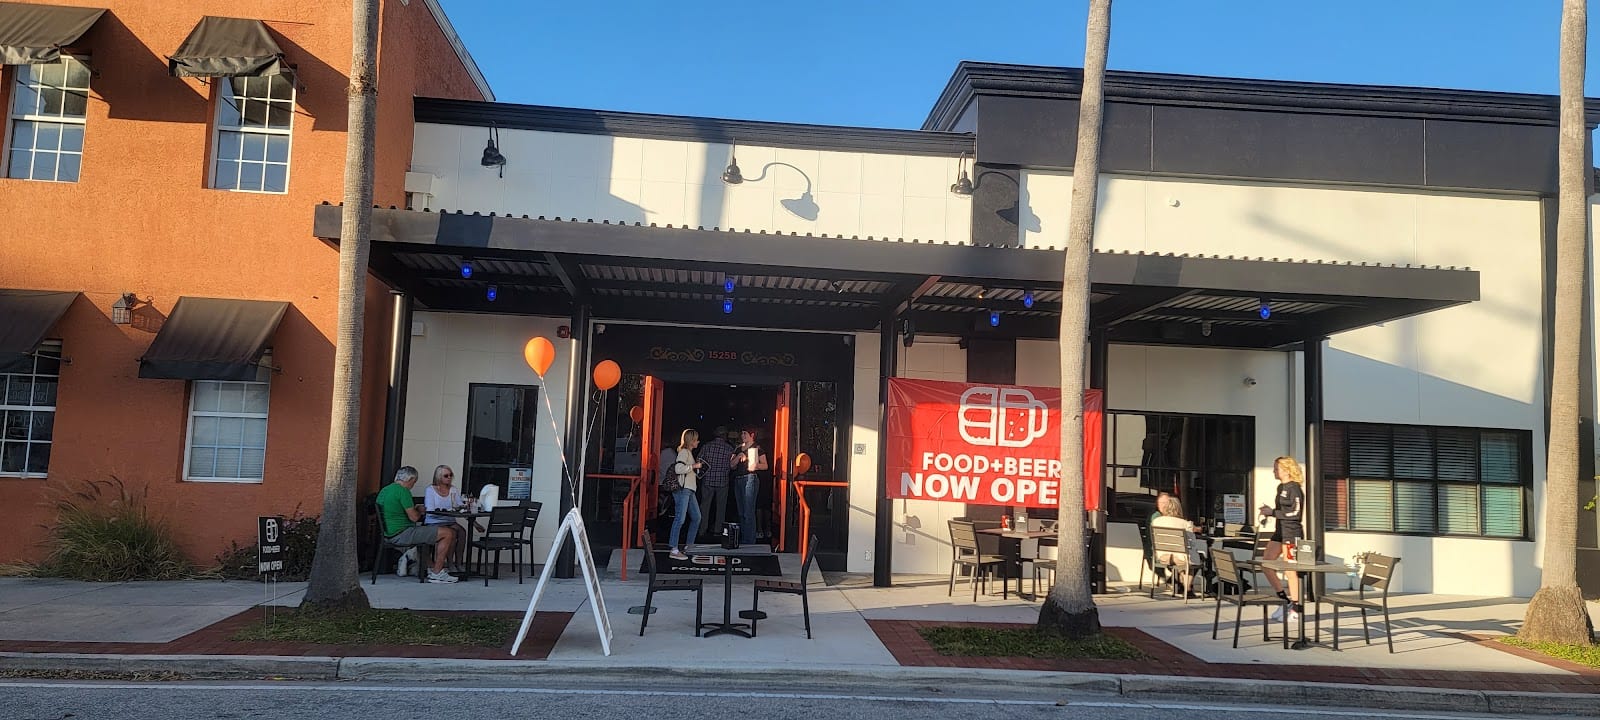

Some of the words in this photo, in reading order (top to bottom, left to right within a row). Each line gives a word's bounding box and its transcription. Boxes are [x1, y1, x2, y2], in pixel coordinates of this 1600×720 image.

[922, 451, 1062, 479] FOOD+BEER
[900, 472, 981, 500] NOW
[990, 477, 1058, 505] OPE
